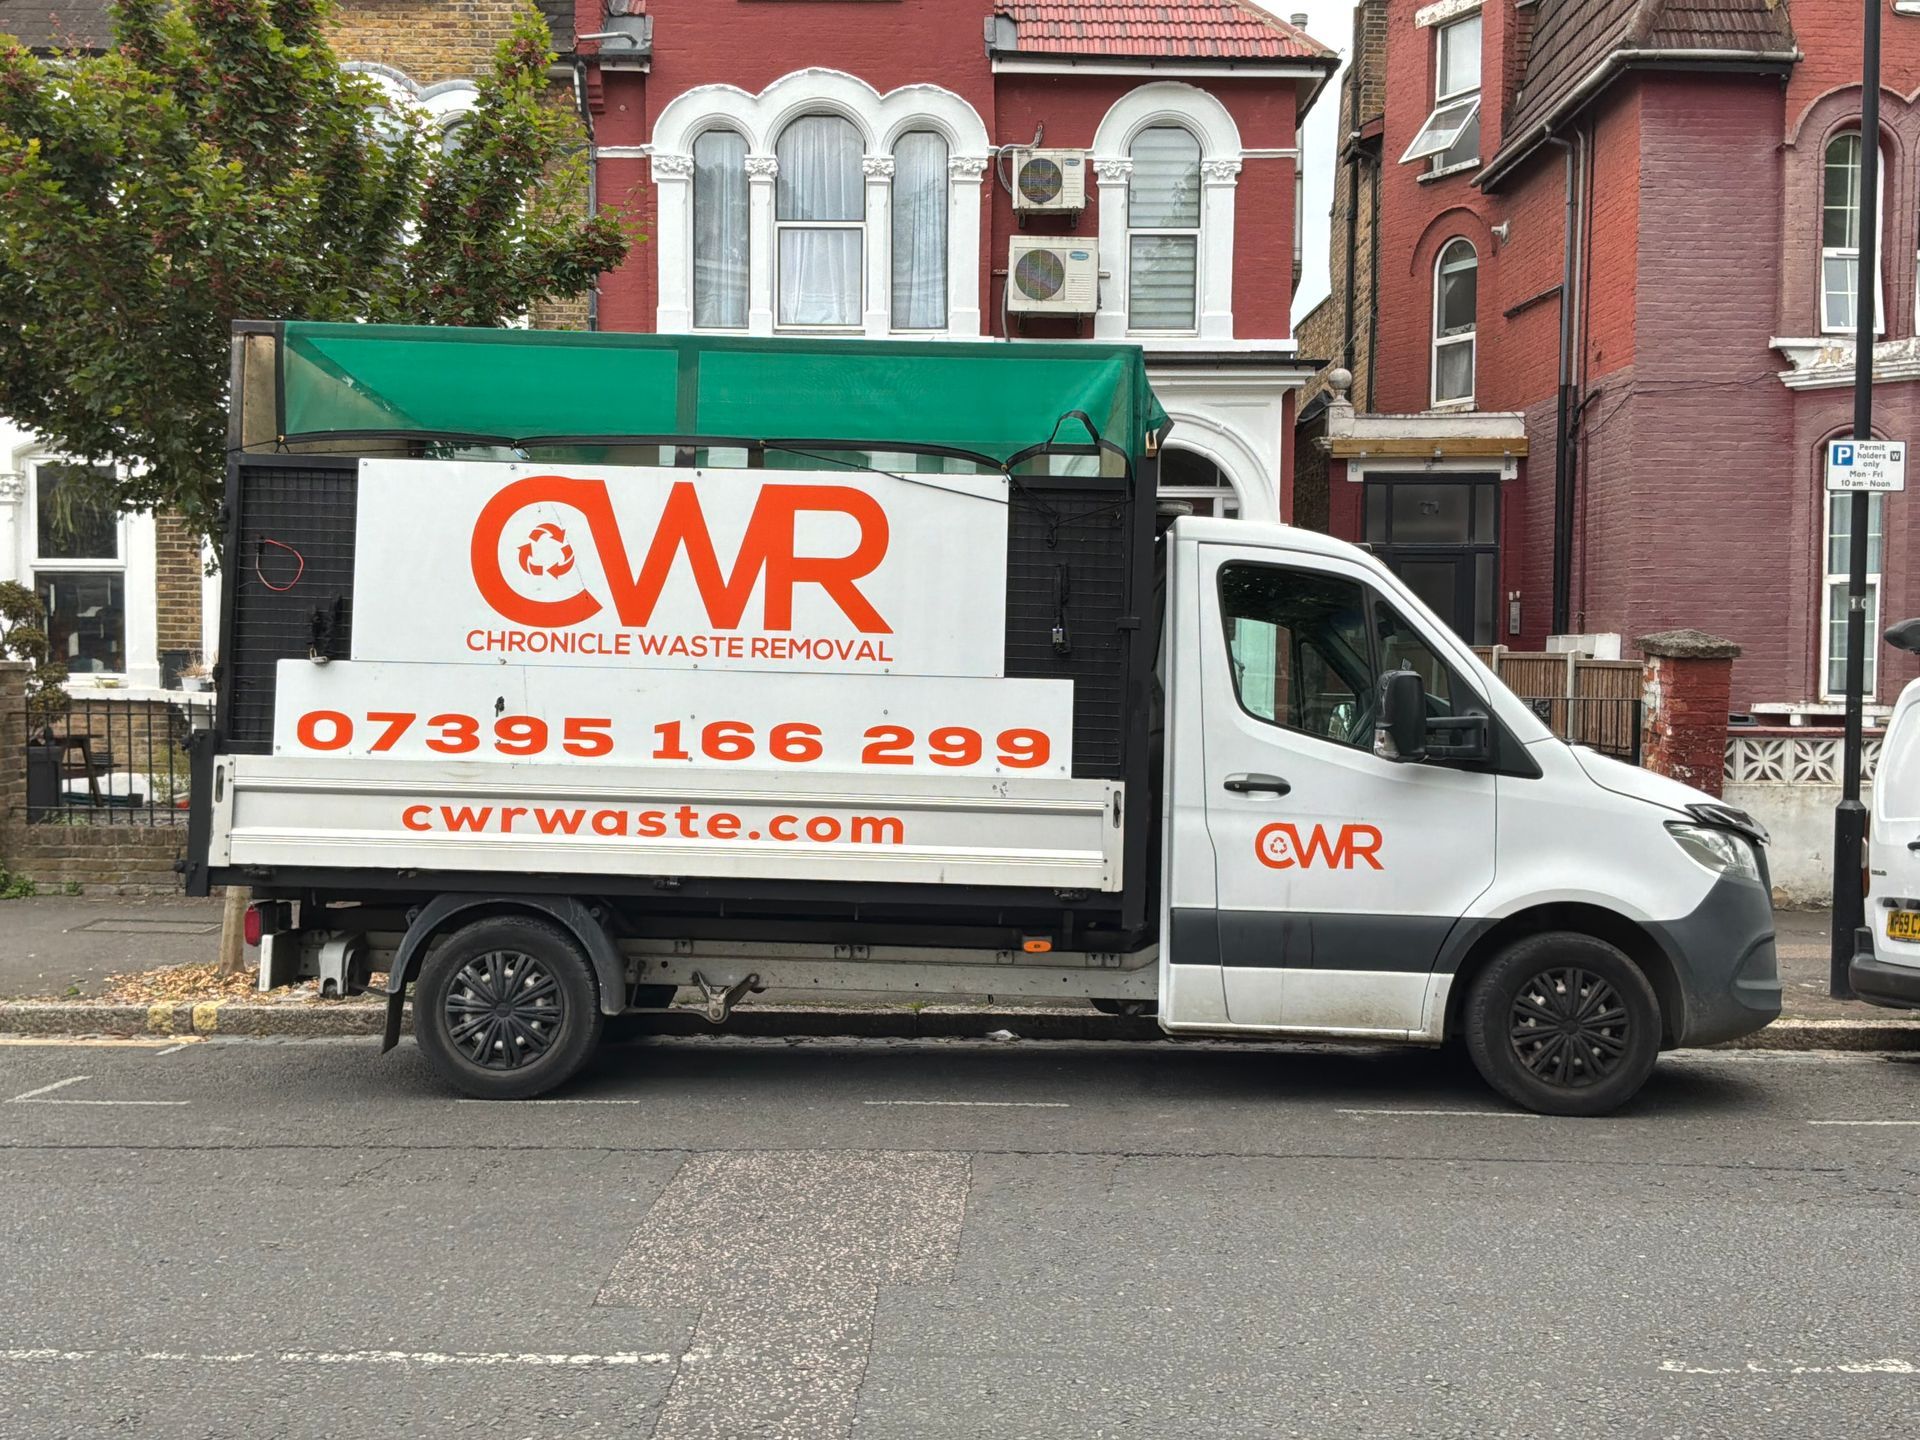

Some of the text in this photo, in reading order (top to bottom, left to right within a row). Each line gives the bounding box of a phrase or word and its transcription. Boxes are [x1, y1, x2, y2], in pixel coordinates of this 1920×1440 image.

[1837, 446, 1851, 465] P
[1859, 443, 1886, 451] Permit
[1891, 452, 1900, 460] W
[1849, 470, 1867, 478] Mon
[1872, 470, 1883, 478] Fri
[1863, 460, 1880, 469] only
[1841, 479, 1850, 487] 10
[471, 475, 893, 634] CWR
[466, 630, 893, 662] CHRONICLE WASTE REMOVAL
[297, 710, 1050, 768] 07395 166 299
[402, 805, 904, 844] cwrwaste.com
[1255, 822, 1383, 870] CWR
